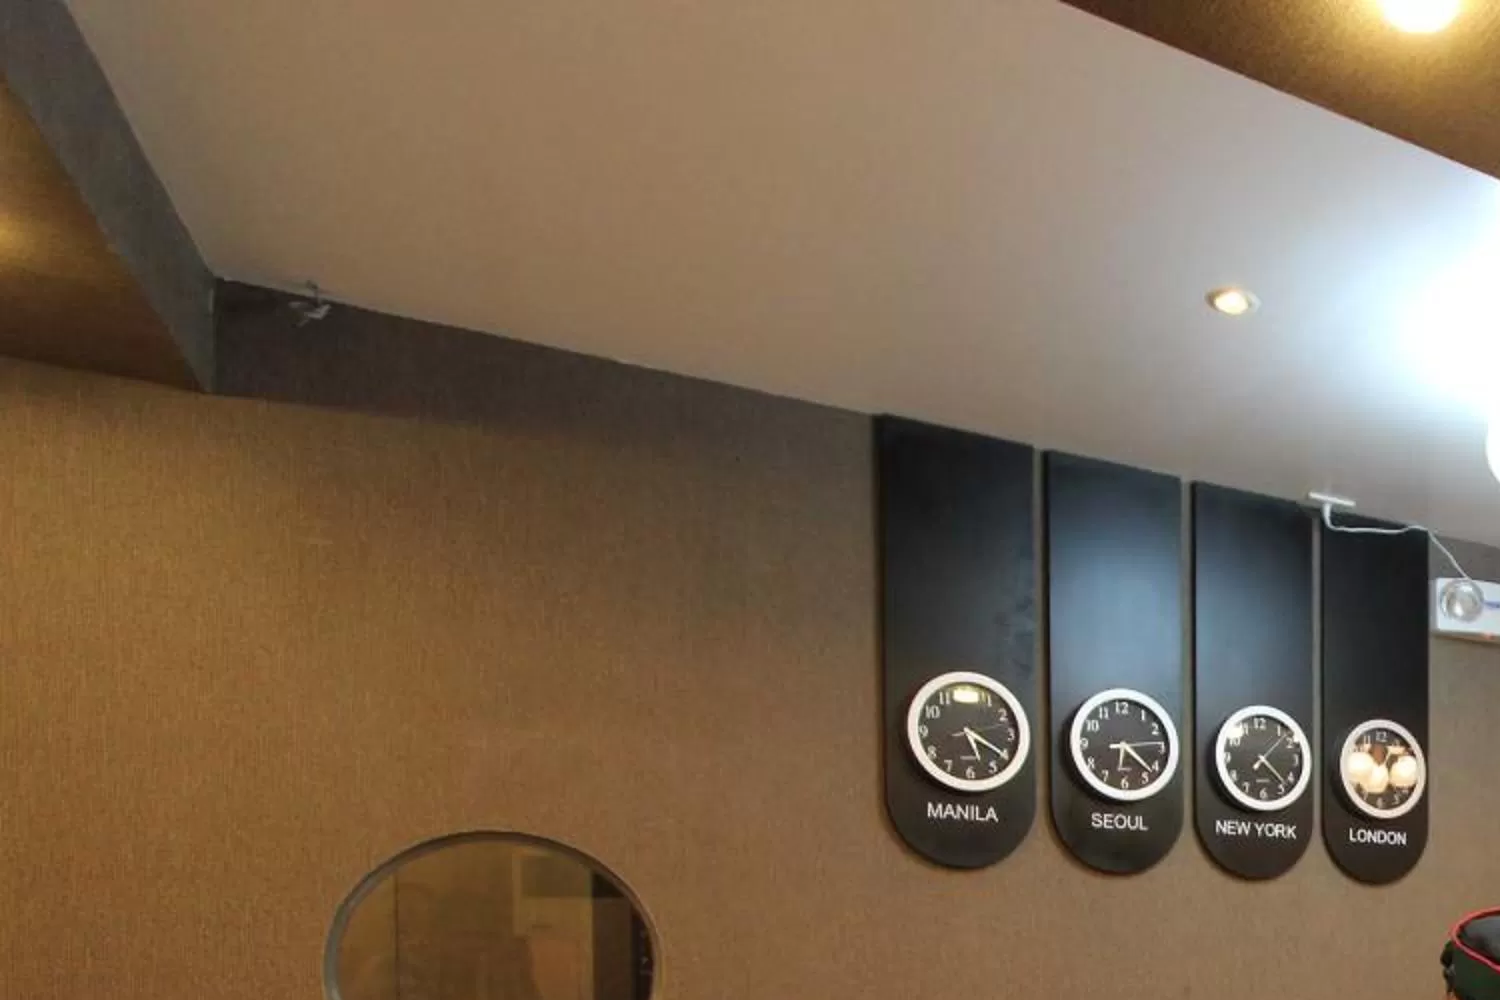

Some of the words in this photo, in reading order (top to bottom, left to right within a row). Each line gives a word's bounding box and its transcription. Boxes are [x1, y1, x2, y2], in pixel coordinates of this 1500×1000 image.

[939, 691, 950, 705] 11
[986, 693, 993, 707] 1
[926, 705, 940, 719] 10
[998, 708, 1008, 721] 2
[1099, 706, 1109, 720] 11
[1115, 701, 1129, 715] 12
[1140, 709, 1146, 721] 1
[1087, 719, 1099, 732] 10
[1151, 722, 1159, 736] 2
[1253, 717, 1267, 730] 12
[919, 725, 929, 738] 9
[1007, 728, 1015, 742] 3
[1276, 724, 1282, 737] 1
[1081, 737, 1089, 750] 9
[1158, 741, 1165, 754] 3
[927, 746, 937, 759] 8
[943, 759, 953, 772] 7
[1087, 756, 1095, 769] 8
[1151, 760, 1159, 772] 4
[1293, 754, 1299, 767] 3
[966, 766, 976, 779] 6
[988, 761, 998, 774] 5
[1101, 769, 1109, 782] 7
[1141, 771, 1149, 784] 5
[1121, 776, 1129, 789] 6
[1242, 781, 1250, 794] 7
[1260, 787, 1268, 800] 6
[927, 801, 999, 823] MANILA
[1091, 812, 1149, 831] SEOUL
[1215, 819, 1251, 836] NEW
[1253, 822, 1297, 840] YORK
[1349, 828, 1407, 846] LONDON
